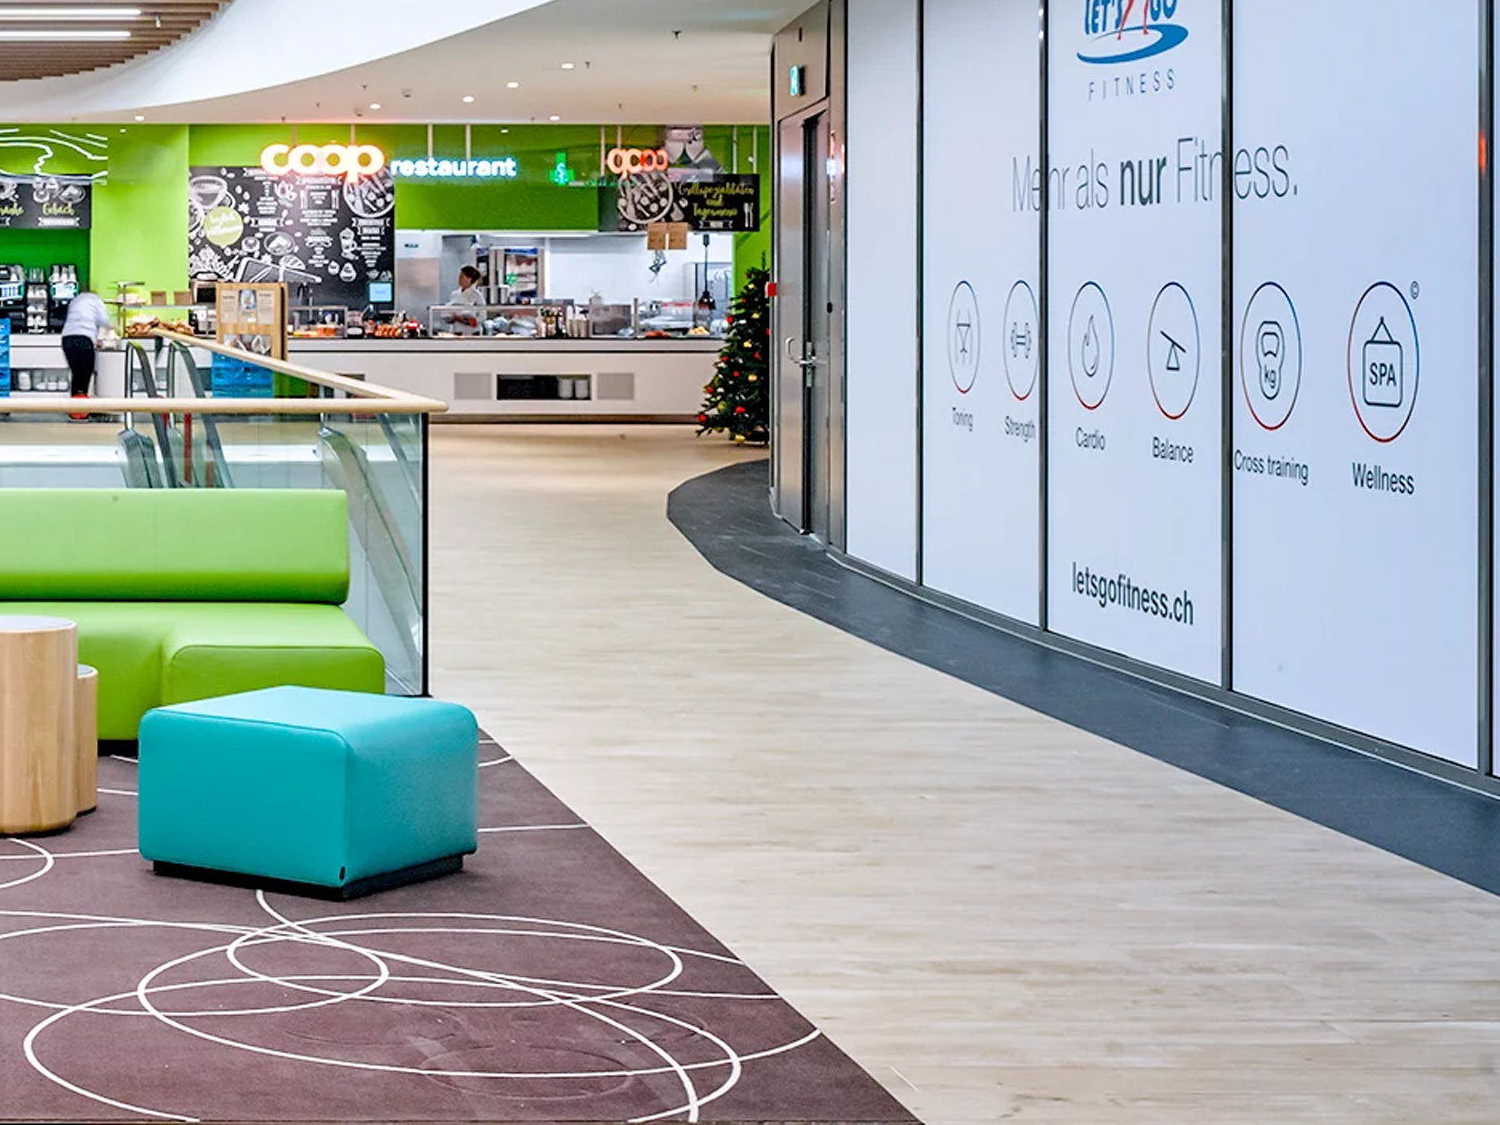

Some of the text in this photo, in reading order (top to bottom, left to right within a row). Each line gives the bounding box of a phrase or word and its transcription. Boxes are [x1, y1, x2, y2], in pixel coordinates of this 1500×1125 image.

[1088, 68, 1176, 101] FITNESS
[260, 143, 518, 183] coop restaurant
[1076, 148, 1109, 210] als
[1120, 156, 1167, 206] nur
[1264, 365, 1277, 390] kg
[1369, 361, 1398, 387] SPA
[952, 407, 974, 432] Toning
[1004, 415, 1037, 443] Strength
[1075, 426, 1107, 451] Cardio
[1152, 436, 1194, 464] Balance
[1234, 448, 1310, 487] Cross training
[1352, 461, 1415, 496] Wellness
[1072, 561, 1194, 626] letsgofitness.ch
